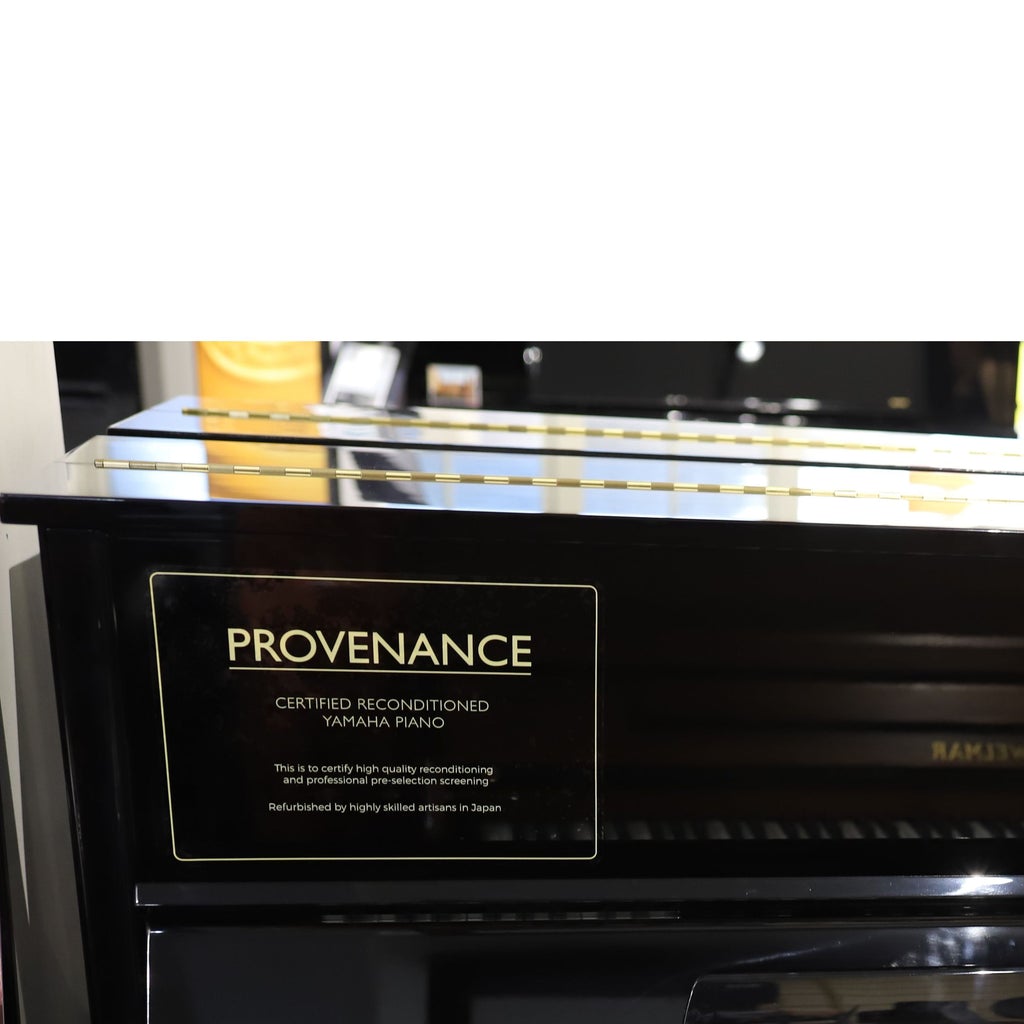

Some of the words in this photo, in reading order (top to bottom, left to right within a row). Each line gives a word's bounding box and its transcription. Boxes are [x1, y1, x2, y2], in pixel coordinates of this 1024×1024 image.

[227, 627, 532, 667] PROVENANCE
[275, 696, 352, 711] CERTIFIED
[357, 697, 490, 712] RECONDITIONED
[322, 715, 391, 728] YAMAHA
[395, 716, 445, 729] PIANO
[274, 763, 295, 773] This
[297, 763, 306, 773] is
[308, 764, 319, 773] to
[320, 764, 353, 775] certify
[355, 764, 380, 775] high
[381, 764, 418, 776] quality
[419, 764, 494, 776] reconditioning
[282, 775, 304, 785] and
[306, 775, 368, 787] professional
[370, 776, 438, 787] pre-selection
[439, 776, 489, 788] screening
[268, 802, 332, 812] Refurbished
[334, 802, 347, 814] by
[349, 802, 381, 814] highly
[383, 803, 416, 812] skilled
[418, 803, 457, 812] artisans
[459, 803, 469, 812] in
[470, 803, 502, 814] Japan
